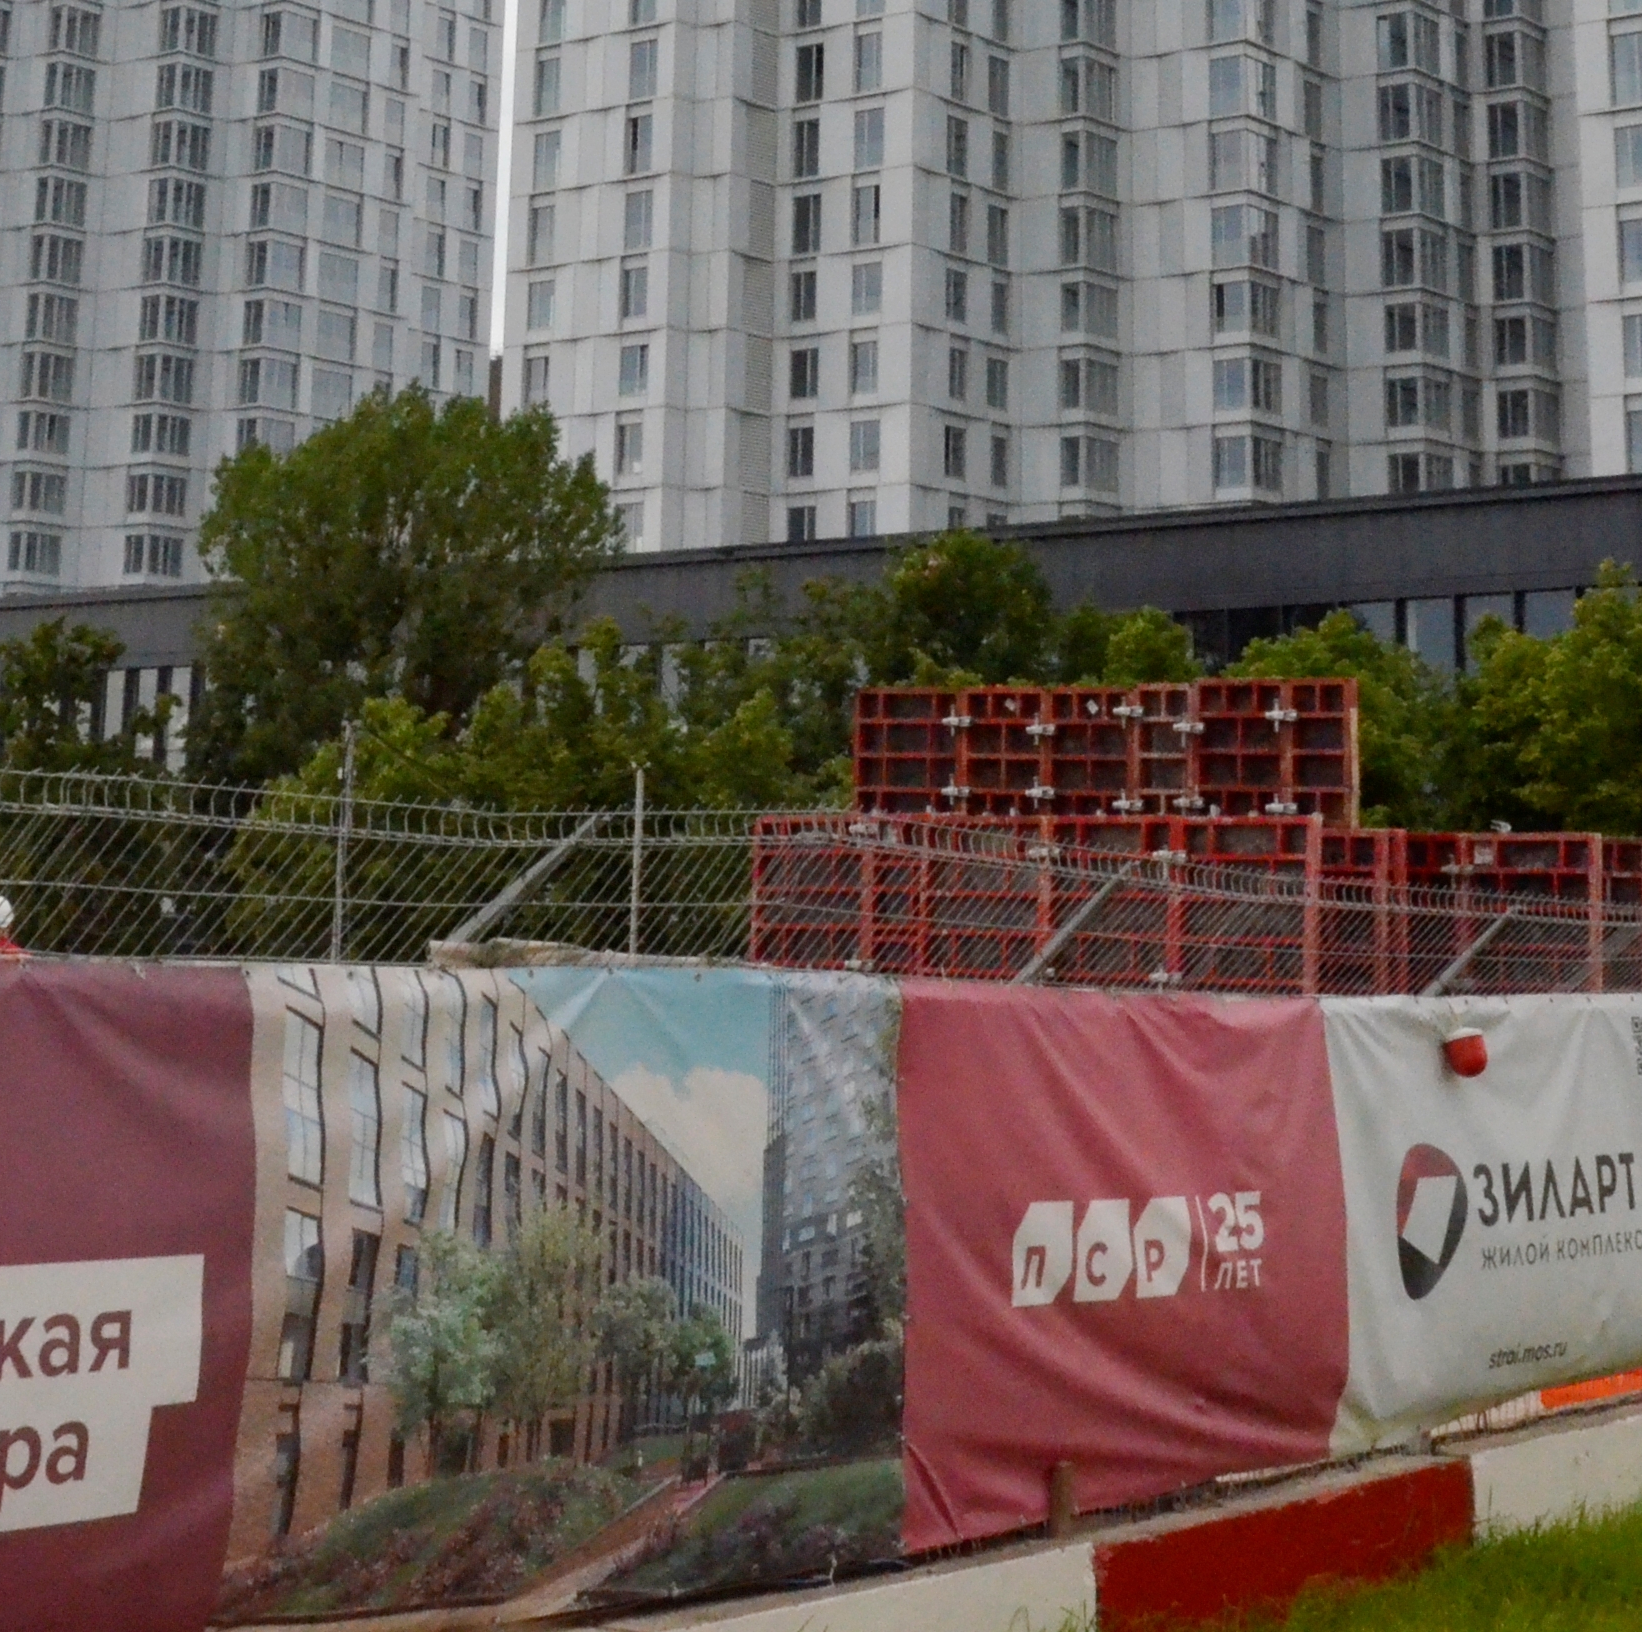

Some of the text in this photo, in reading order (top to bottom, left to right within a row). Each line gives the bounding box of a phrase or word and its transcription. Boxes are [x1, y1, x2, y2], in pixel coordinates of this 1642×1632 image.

[1473, 1152, 1636, 1227] ЗИЛАРТ
[1207, 1190, 1265, 1253] 25
[1214, 1257, 1263, 1291] ЛЕТ
[1481, 1234, 1550, 1270] ЖИЛОЙ
